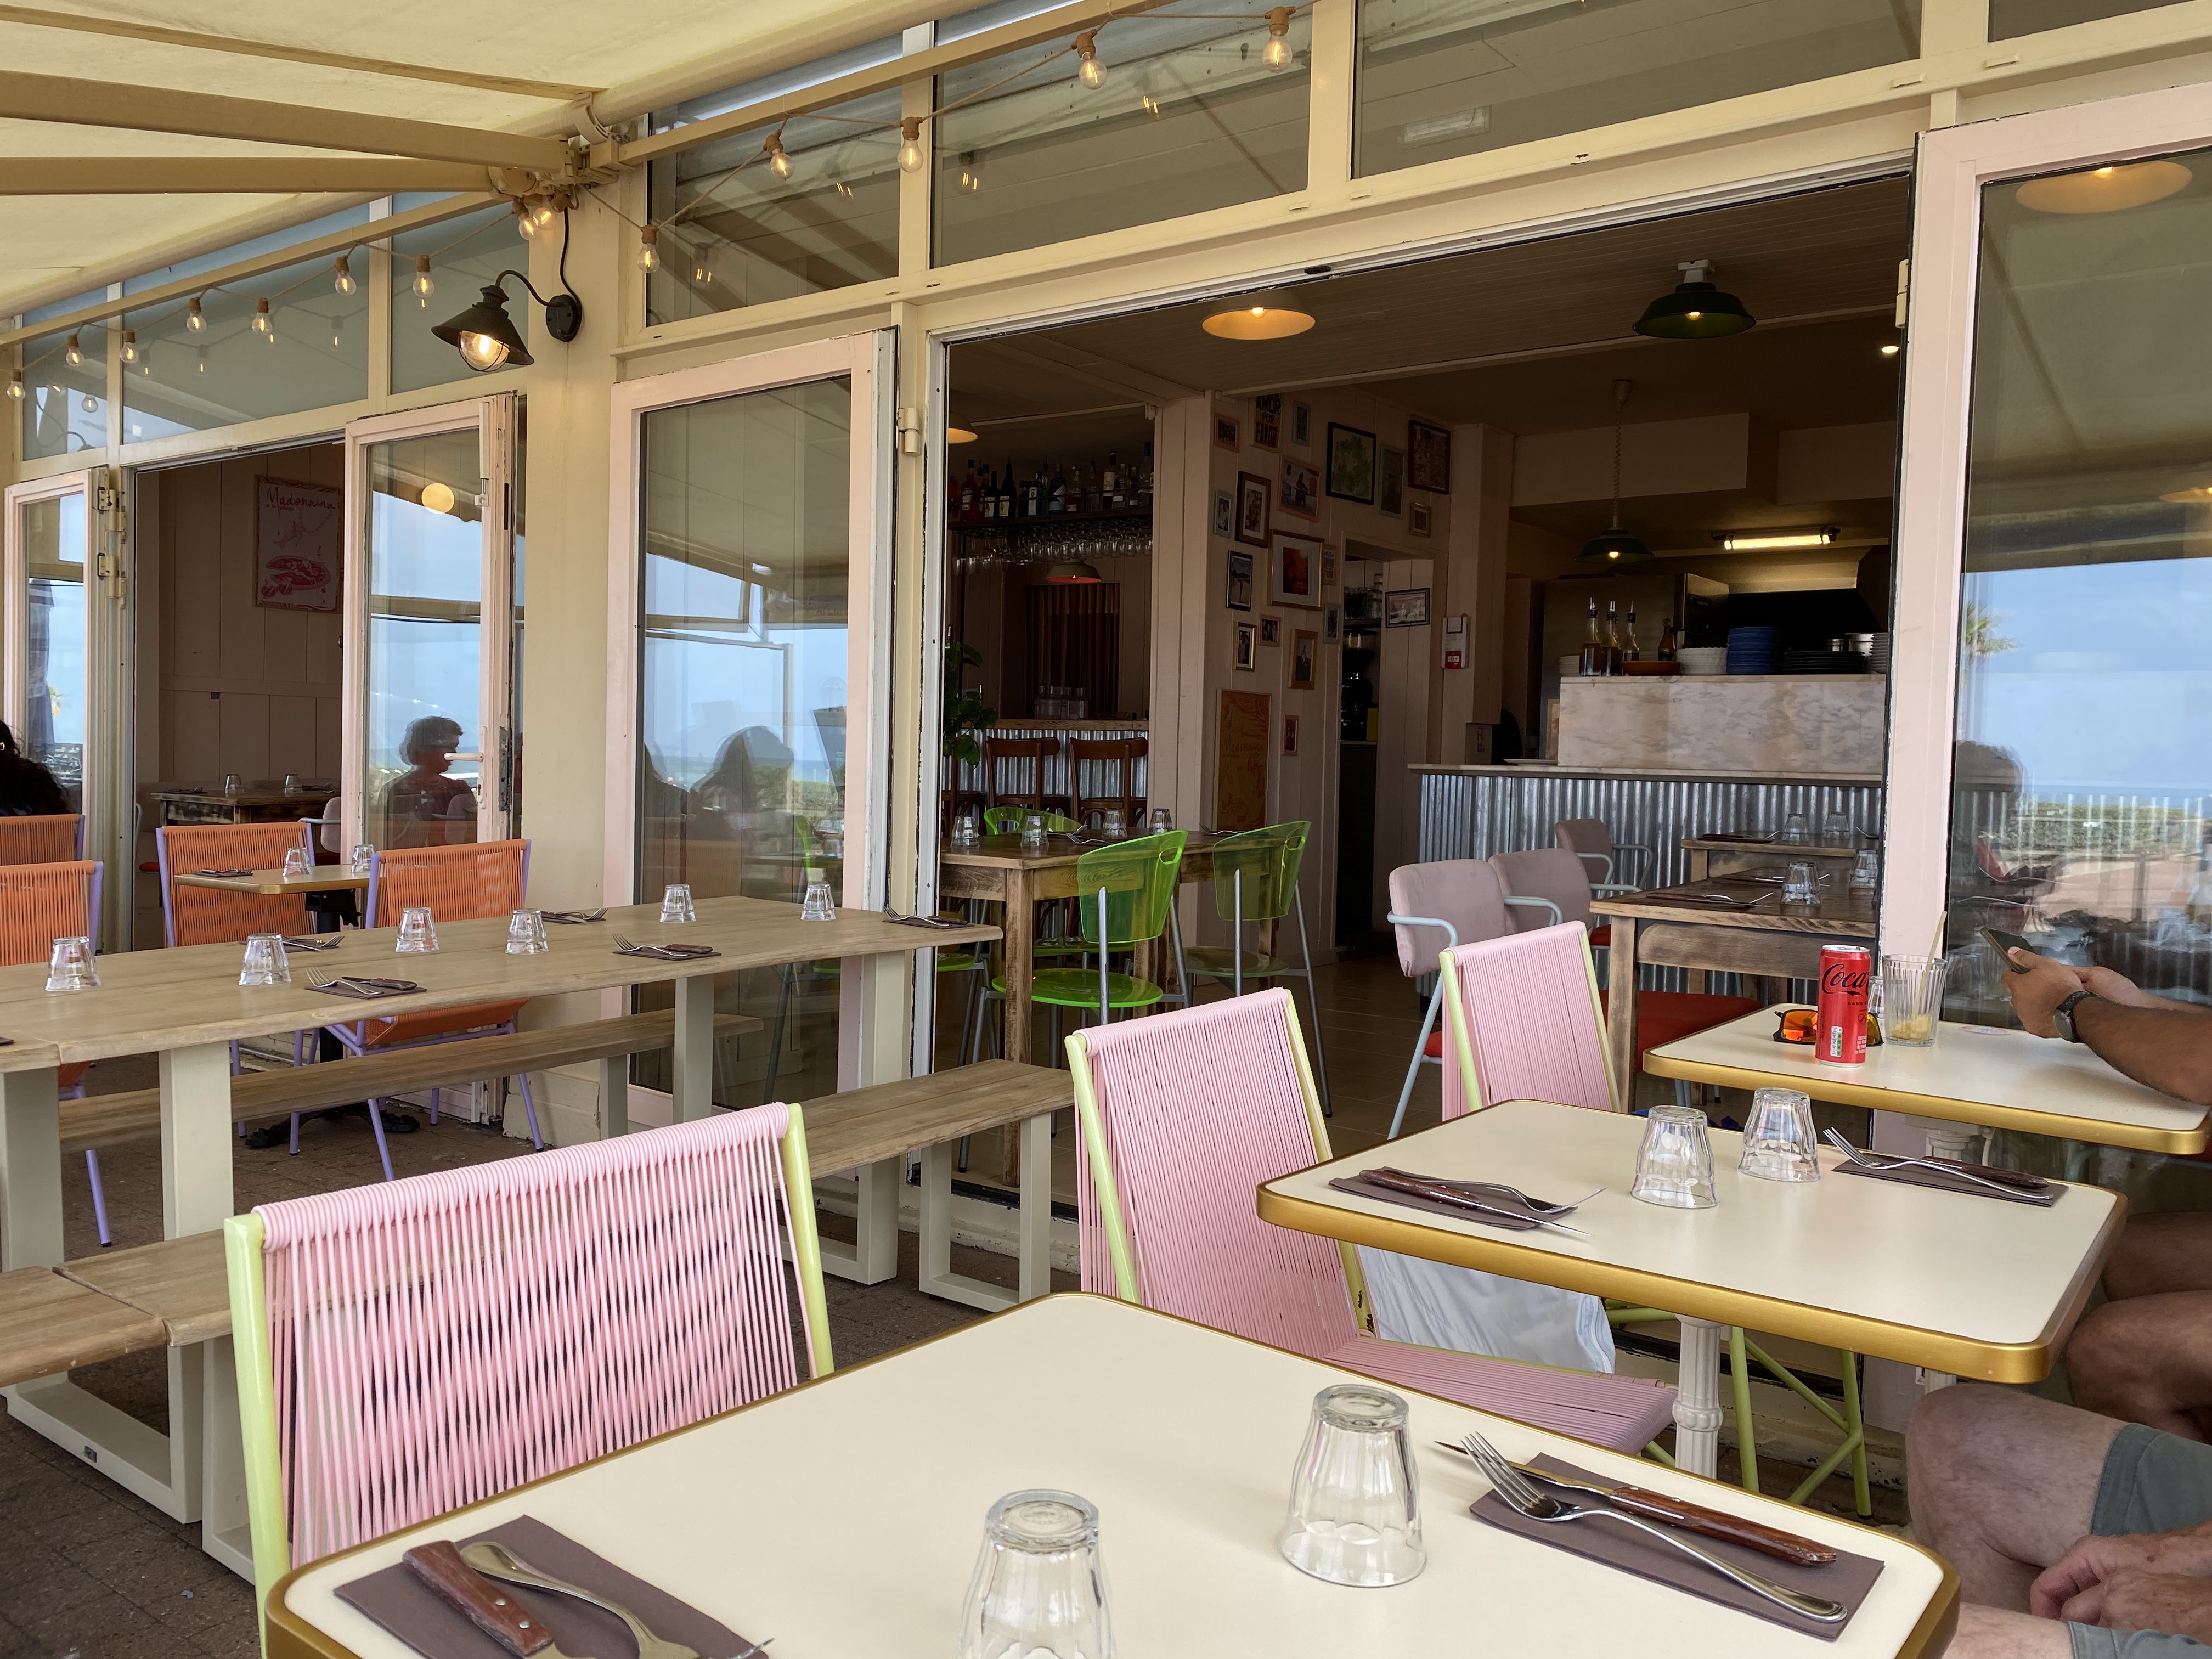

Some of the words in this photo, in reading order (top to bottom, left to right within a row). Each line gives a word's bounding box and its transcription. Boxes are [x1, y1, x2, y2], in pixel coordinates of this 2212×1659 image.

[1256, 395, 1282, 416] AMOR
[1262, 412, 1274, 425] POR
[1255, 421, 1278, 448] FAVOR
[267, 487, 336, 518] Madonnina
[1822, 963, 1869, 996] Coca
